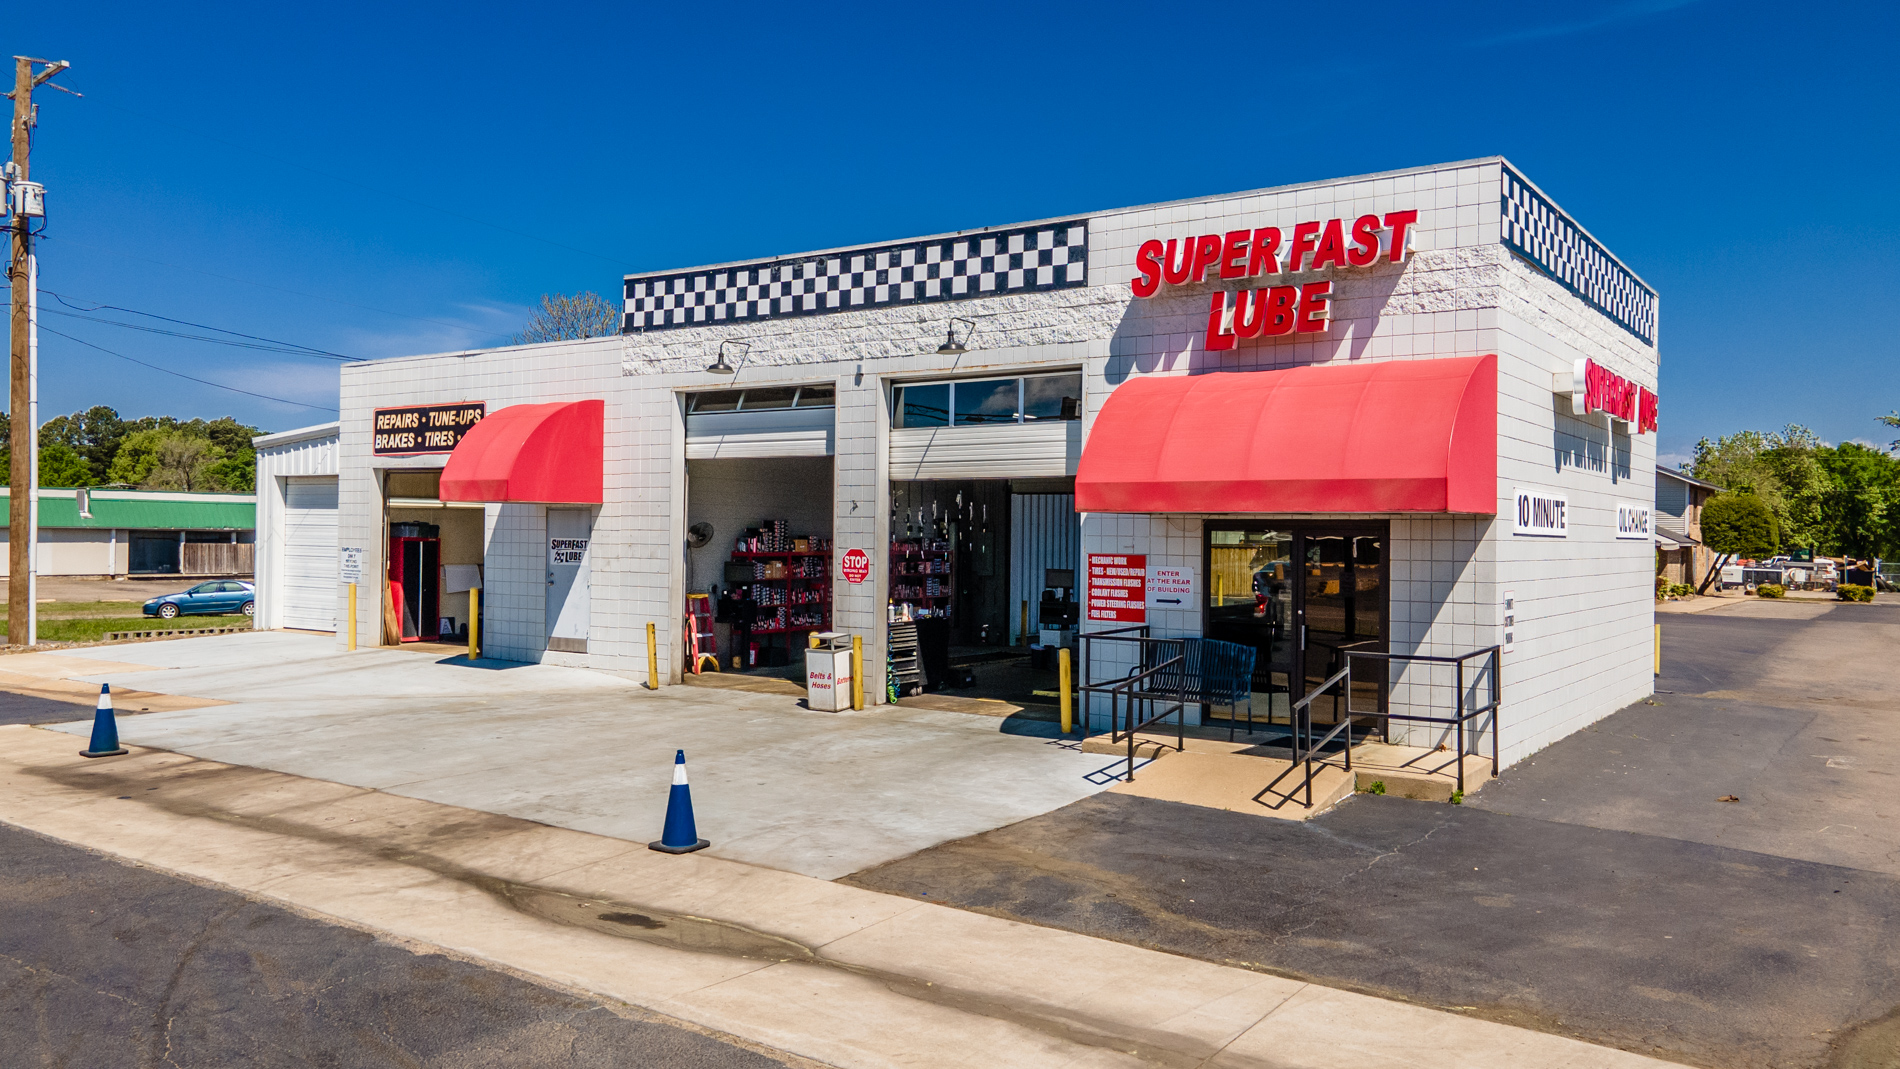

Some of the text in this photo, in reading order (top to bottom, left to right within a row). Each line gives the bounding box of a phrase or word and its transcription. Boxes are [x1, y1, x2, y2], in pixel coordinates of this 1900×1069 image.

[1205, 280, 1334, 351] LUBE
[377, 408, 482, 430] REPAIRS TUNE-UPS
[375, 430, 455, 449] BRAKES TIRES
[1518, 494, 1566, 529] 10 MINUTE
[1628, 507, 1648, 534] CHANGE
[551, 539, 588, 550] SUPERFAST
[565, 551, 582, 563] LUBE
[844, 556, 868, 568] STOP
[810, 672, 825, 680] Belts
[812, 682, 832, 690] Hoses
